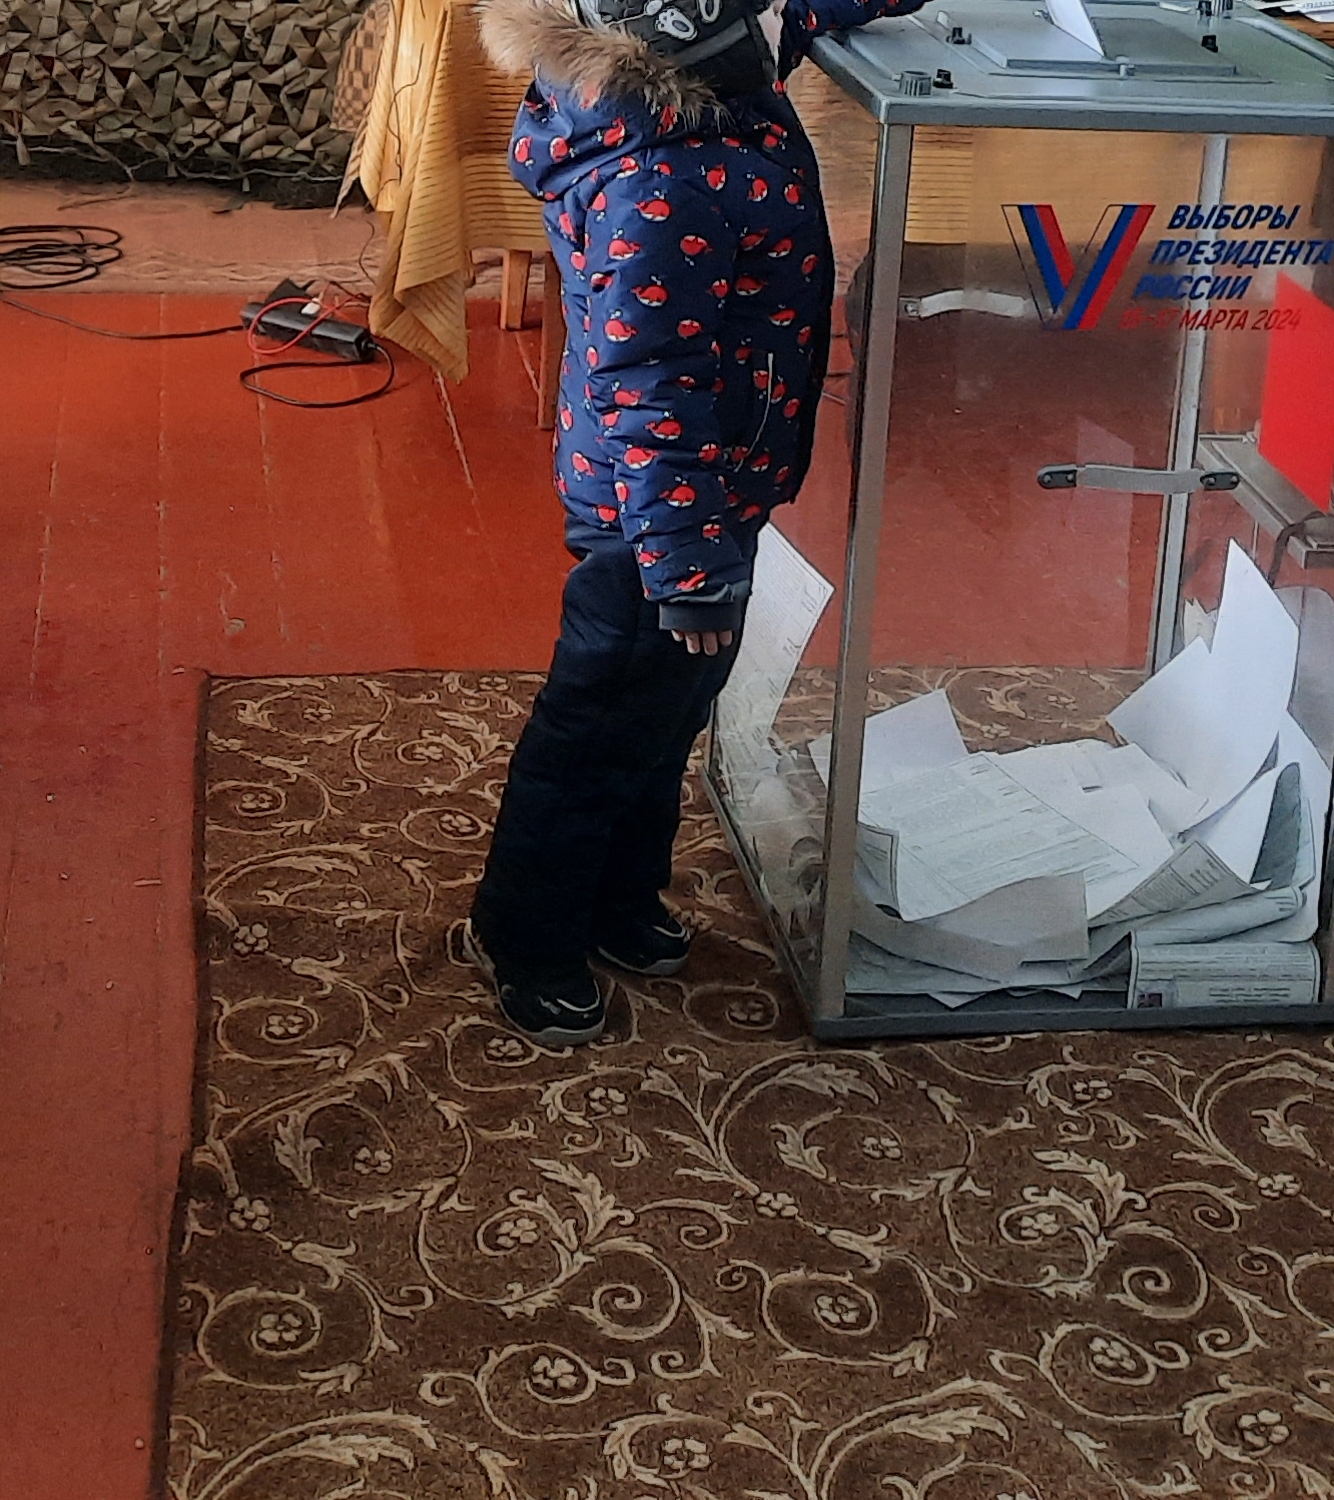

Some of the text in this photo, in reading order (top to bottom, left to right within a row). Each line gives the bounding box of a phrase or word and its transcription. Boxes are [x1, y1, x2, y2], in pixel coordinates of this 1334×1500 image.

[1167, 204, 1301, 230] ВЫБОРЫ
[1149, 239, 1334, 268] ПРЕЗИДЕНТА
[1134, 275, 1252, 300] РОССИИ
[1179, 308, 1250, 331] МАРТА
[1251, 308, 1302, 331] 2024
